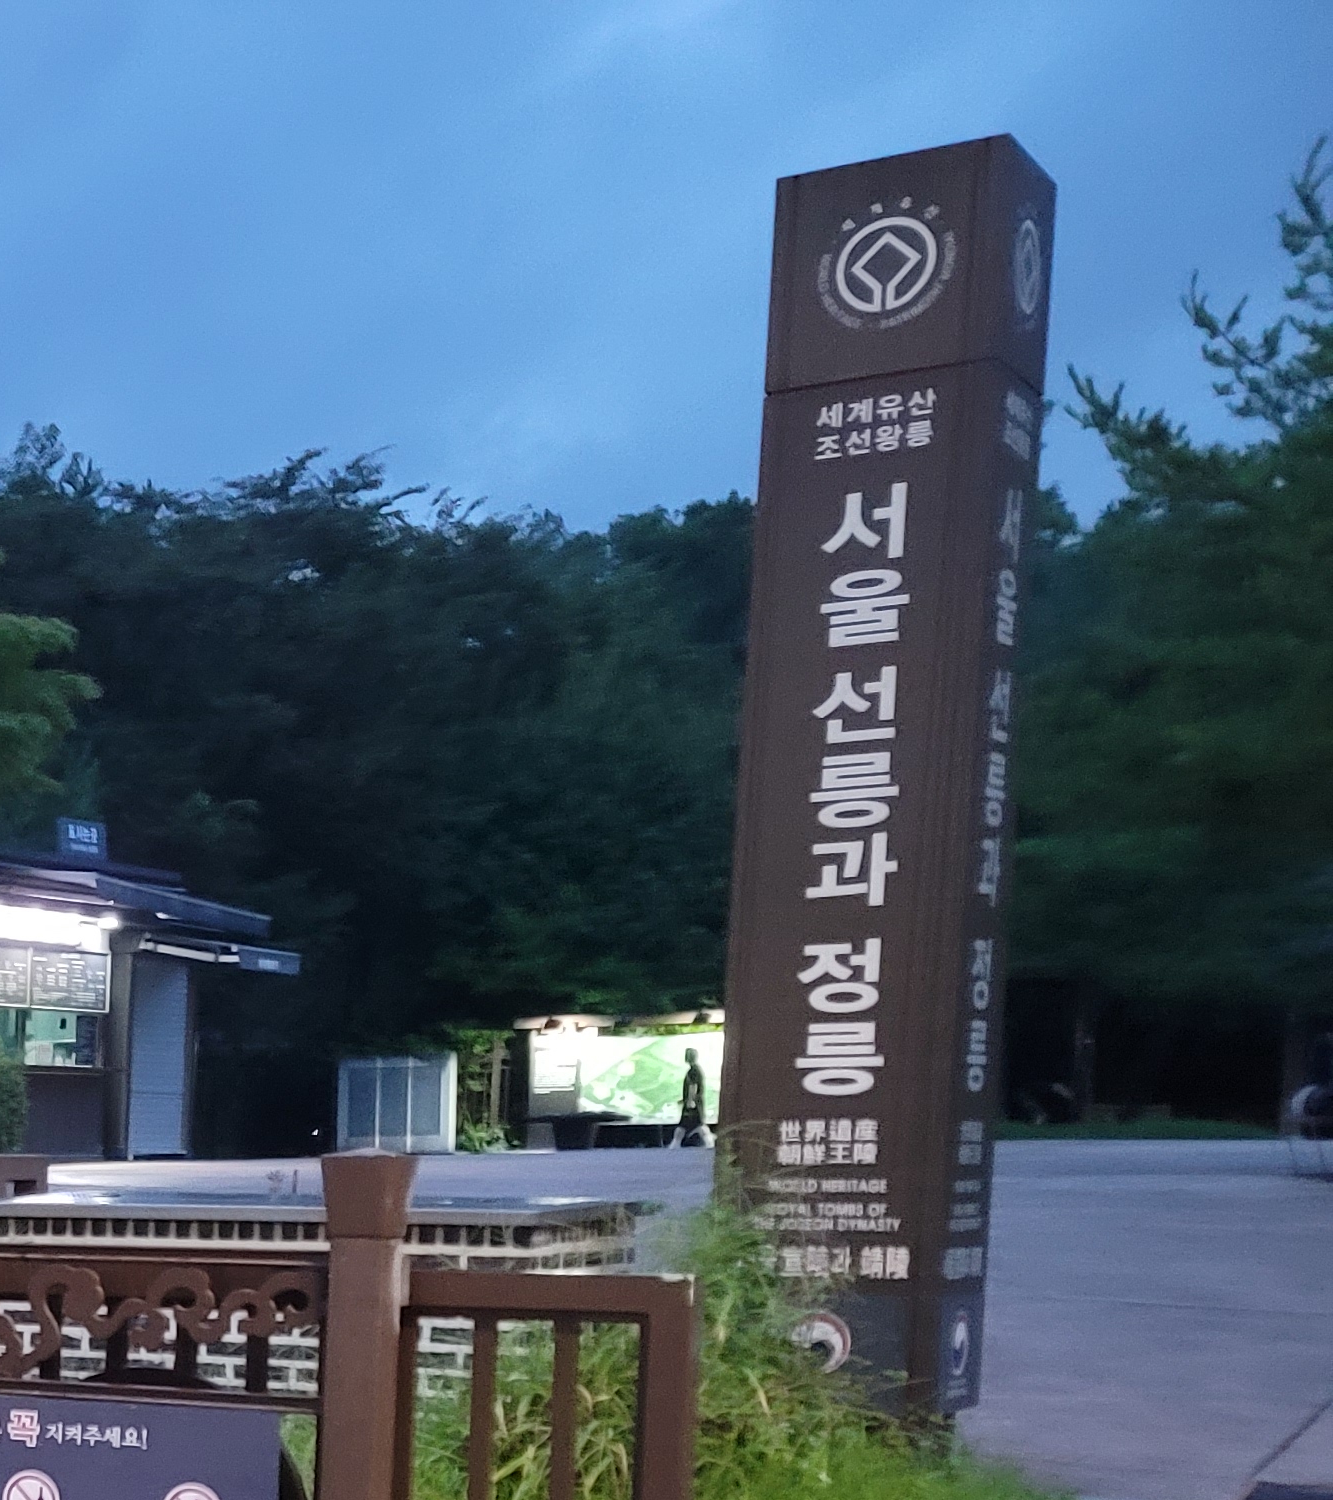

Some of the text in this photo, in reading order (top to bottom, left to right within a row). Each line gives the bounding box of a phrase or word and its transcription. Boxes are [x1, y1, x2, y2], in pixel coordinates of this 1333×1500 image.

[816, 387, 937, 428] 세계유산
[813, 420, 933, 461] 조선왕릉
[795, 482, 911, 1096] 서울 선릉과 정릉
[821, 1178, 888, 1193] HERITAGE
[818, 1202, 864, 1217] TOMBS
[867, 1203, 888, 1217] OF
[837, 1218, 902, 1232] DYNASTY
[7, 1408, 41, 1448] 꼭
[45, 1421, 148, 1450] 지켜주세요!
